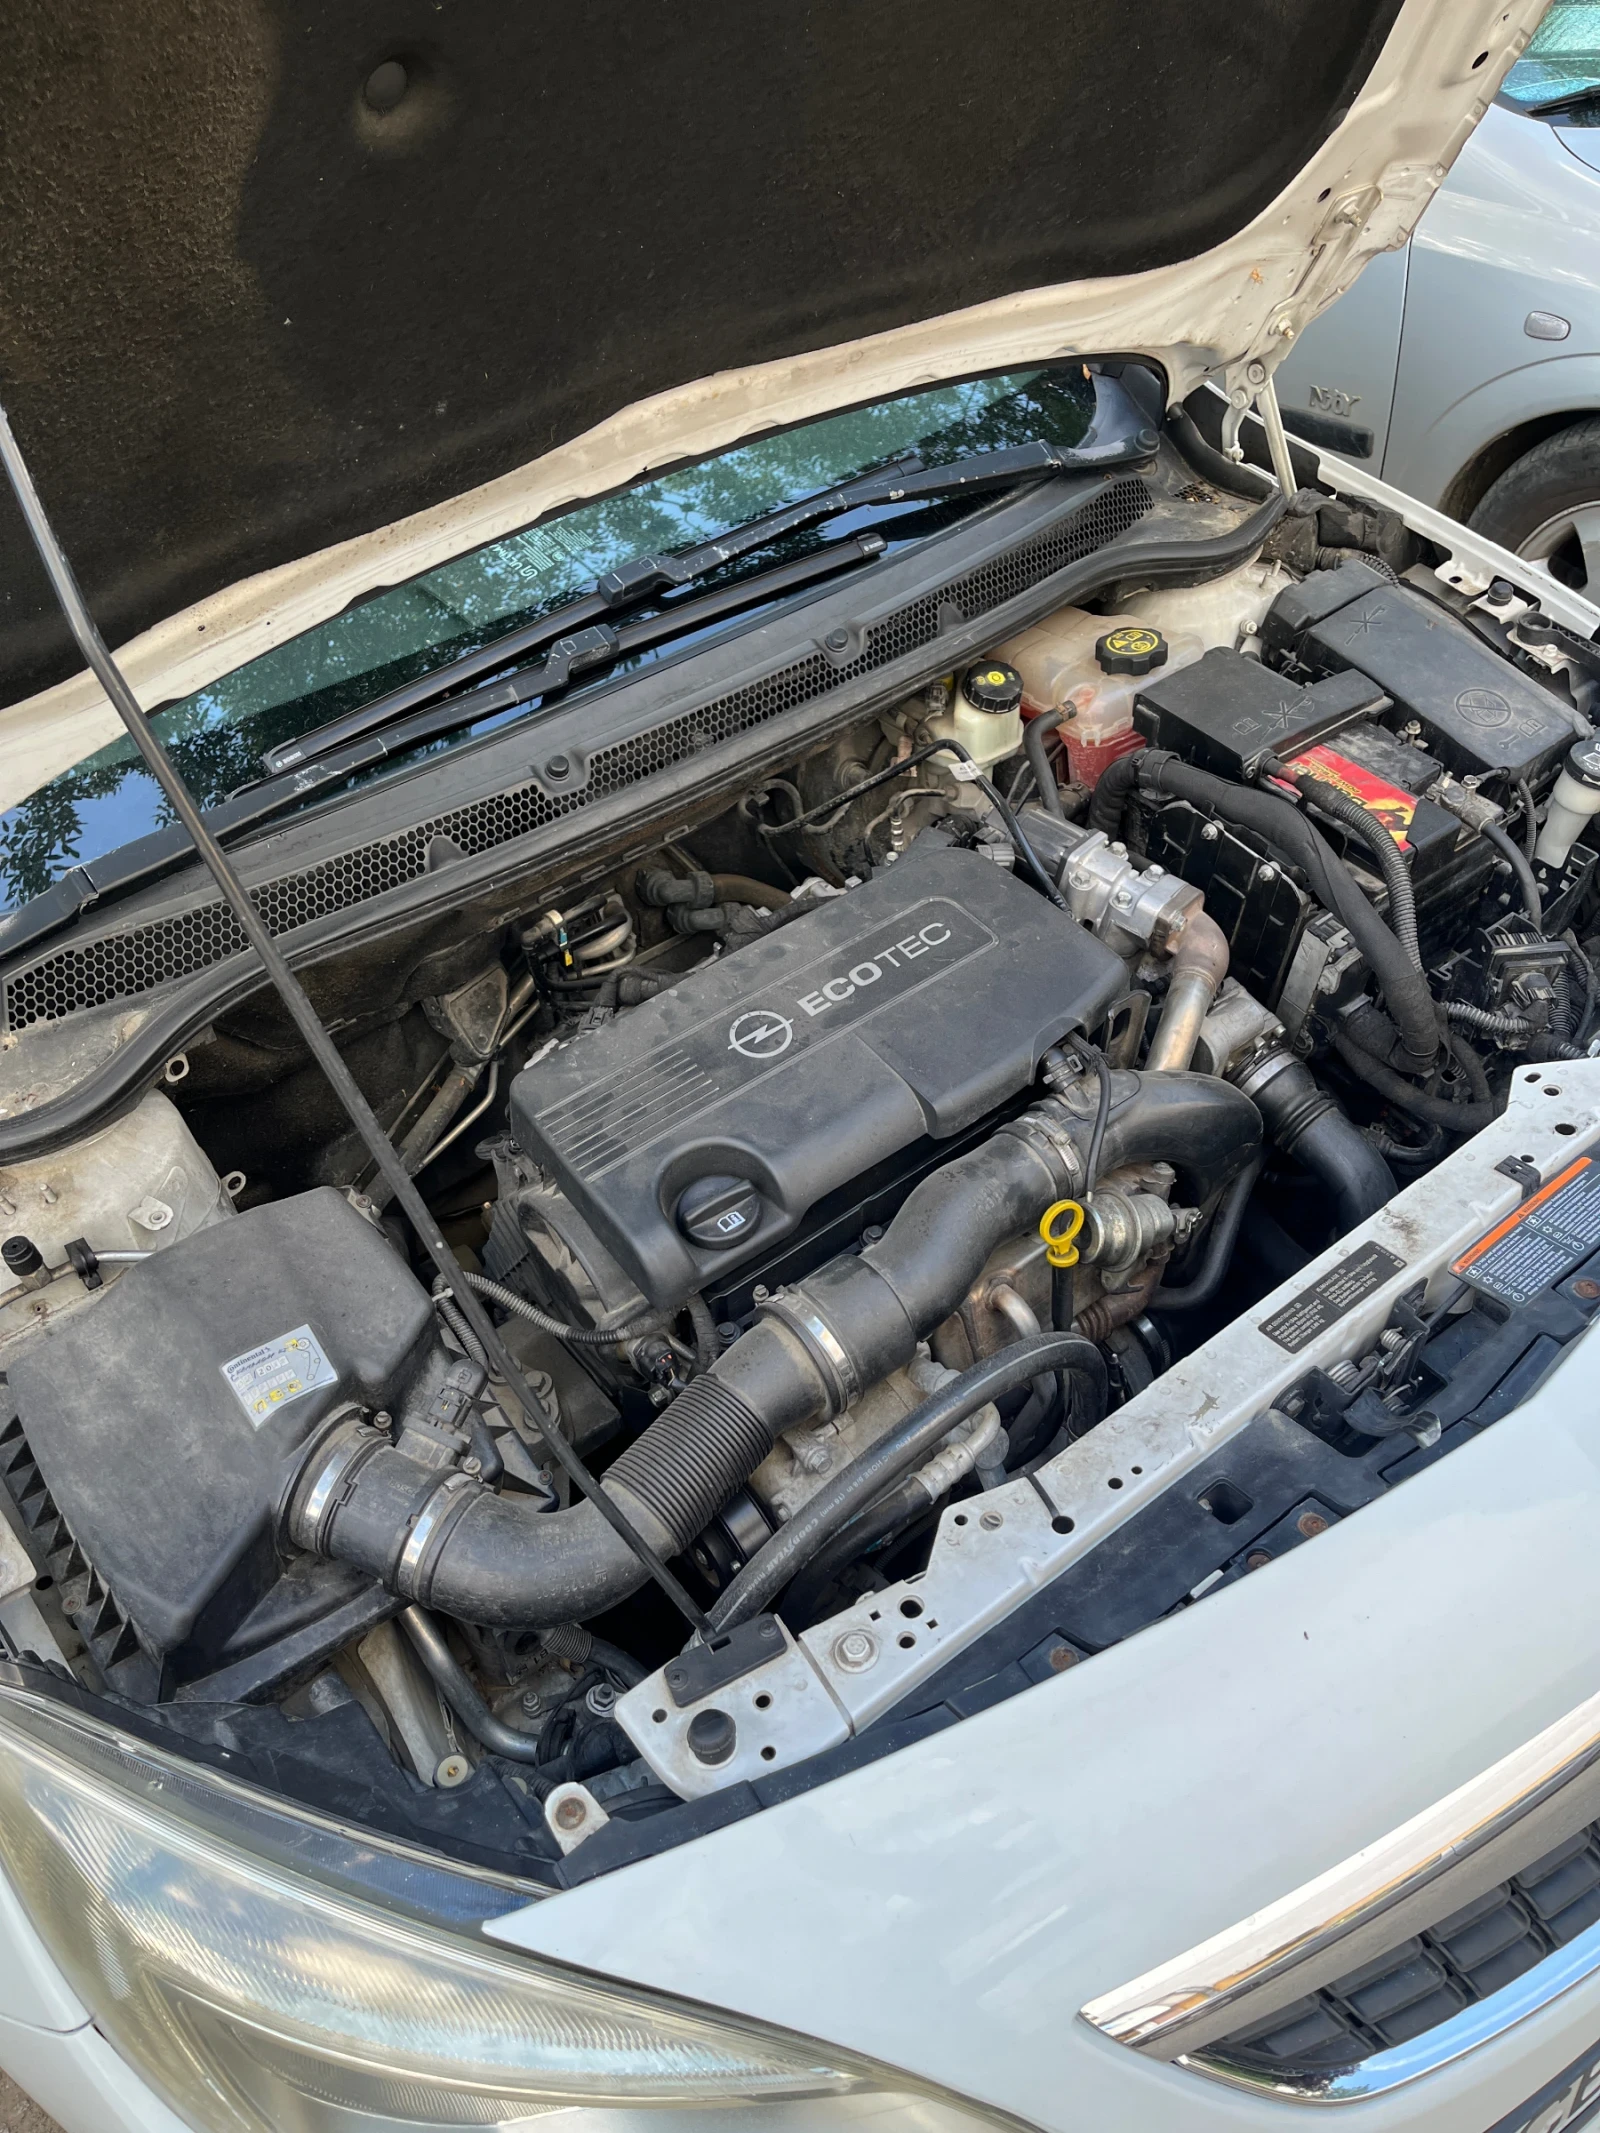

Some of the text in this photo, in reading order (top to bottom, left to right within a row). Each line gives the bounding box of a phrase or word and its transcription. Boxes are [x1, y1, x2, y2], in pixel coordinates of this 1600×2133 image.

[796, 922, 951, 1017] ECOTEC
[227, 1349, 266, 1373] Continental
[863, 1460, 884, 1479] HOSE
[766, 1518, 818, 1571] GOODYEAR
